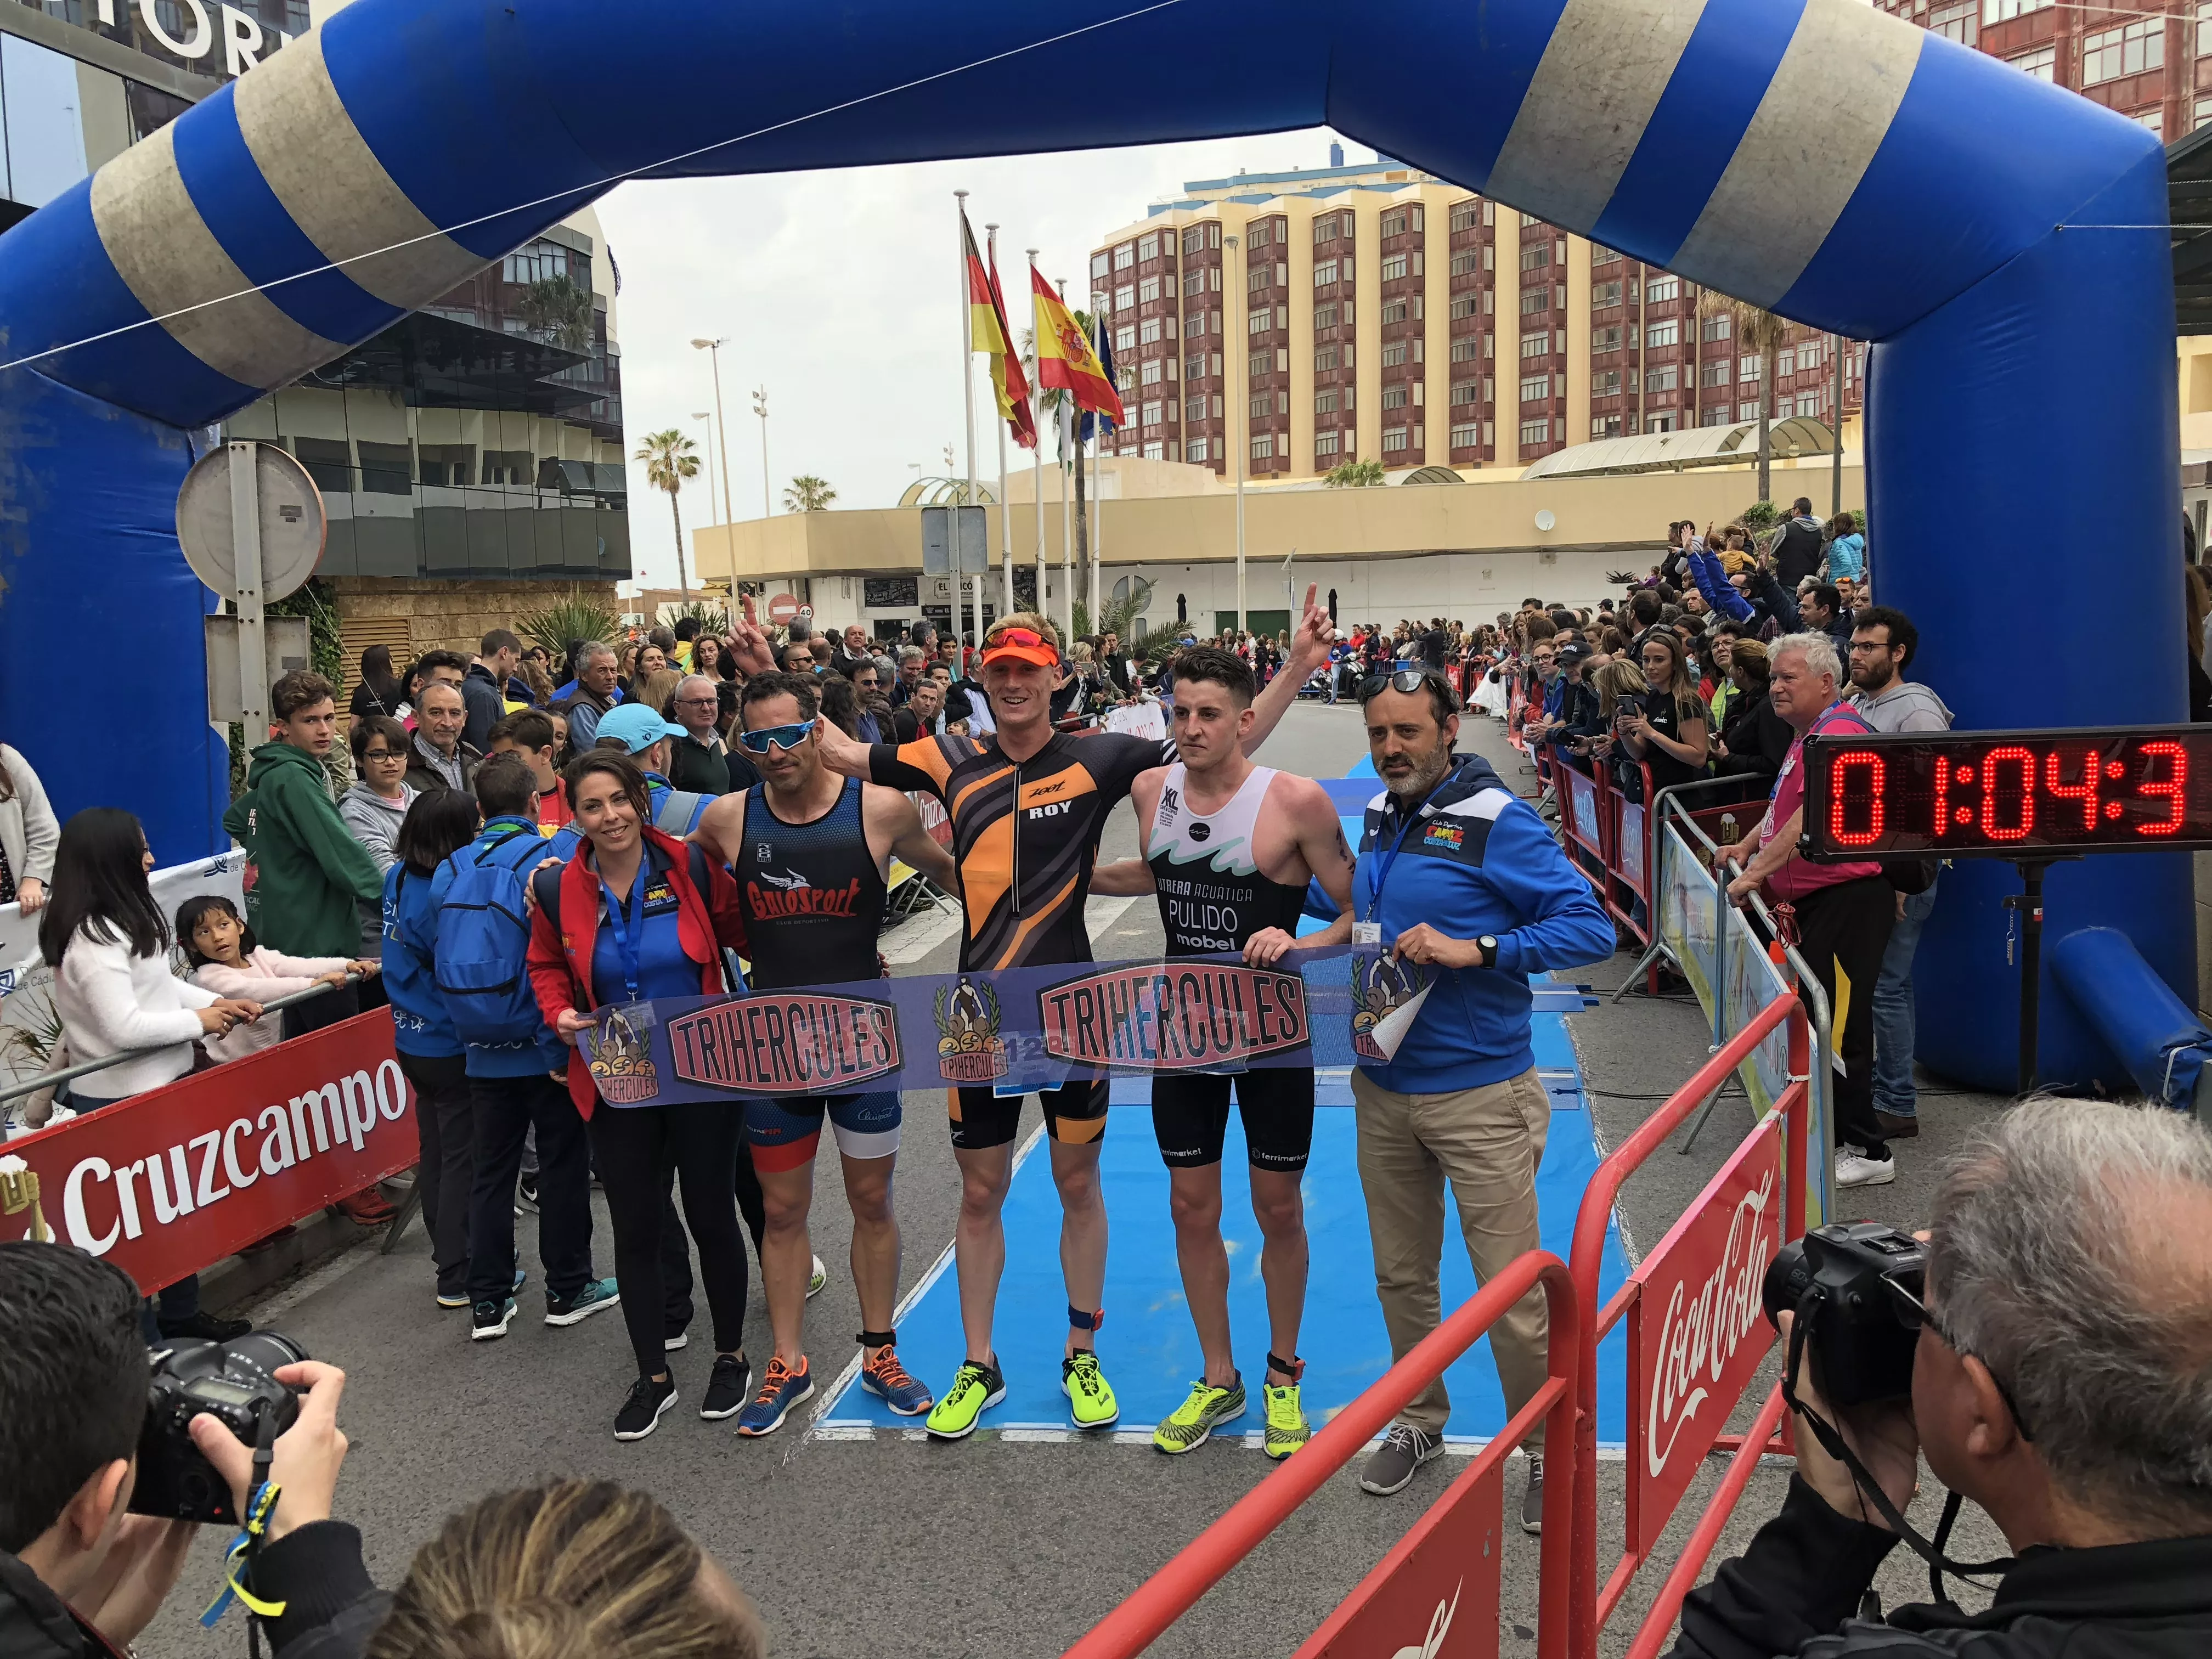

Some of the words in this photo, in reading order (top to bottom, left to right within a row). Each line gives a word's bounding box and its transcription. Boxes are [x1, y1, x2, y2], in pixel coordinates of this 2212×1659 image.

[939, 583, 948, 591] EL
[1029, 800, 1072, 820] ROY
[1157, 877, 1191, 896] UTRERA
[1169, 899, 1238, 933] PULIDO
[1176, 933, 1236, 951] mobel
[1050, 972, 1300, 1060] TRIHERCULES
[676, 1002, 891, 1083] TRIHERCULES
[941, 1054, 1007, 1079] TRIHERCULES
[63, 1058, 407, 1257] Cruzcampo
